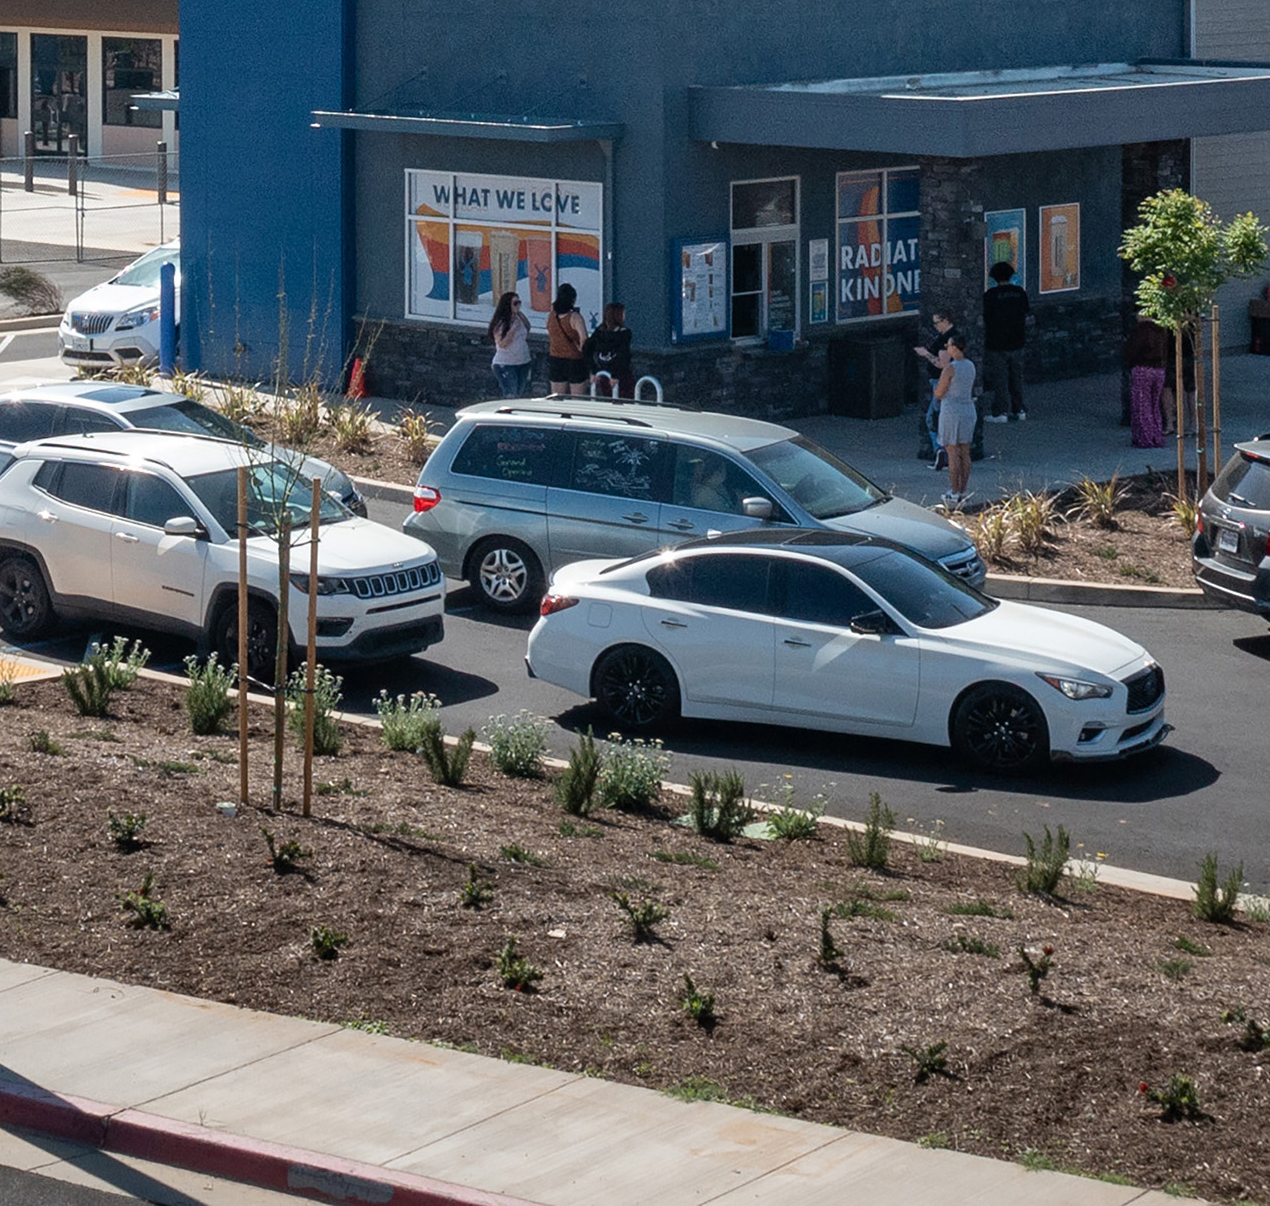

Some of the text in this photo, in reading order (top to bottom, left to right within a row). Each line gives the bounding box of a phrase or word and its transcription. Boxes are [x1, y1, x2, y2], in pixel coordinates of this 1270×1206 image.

[433, 185, 580, 215] WHAT WE LOVE
